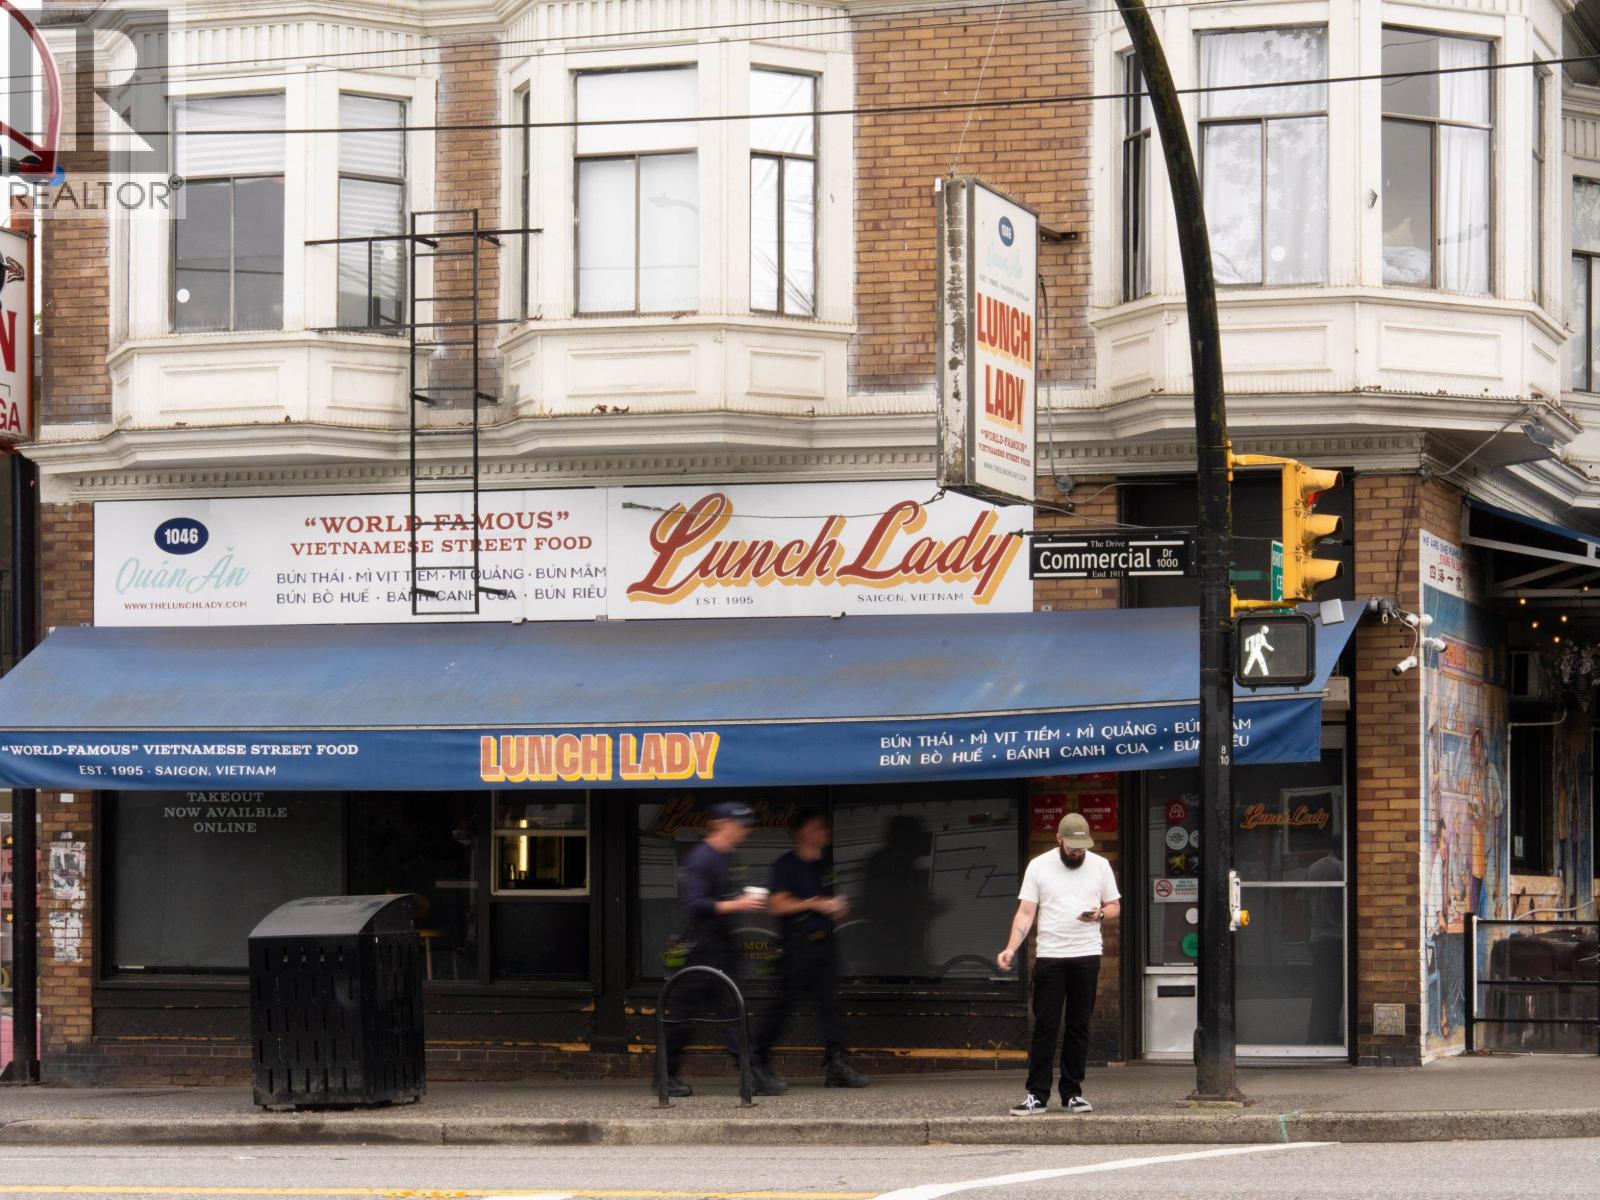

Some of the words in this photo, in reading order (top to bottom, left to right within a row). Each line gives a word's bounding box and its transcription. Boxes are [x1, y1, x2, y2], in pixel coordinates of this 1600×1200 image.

[976, 292, 1033, 371] LUNCH
[984, 364, 1027, 432] LADY
[165, 528, 199, 545] 1046
[1090, 540, 1104, 548] The
[1105, 539, 1125, 548] Drive
[290, 539, 434, 556] VIETNAMESE
[441, 538, 527, 554] STREET
[534, 536, 593, 551] FOOD
[626, 492, 848, 606] Lunch
[835, 499, 1024, 606] Lady
[1039, 549, 1151, 570] Commercial
[1162, 549, 1173, 558] Dr
[1157, 558, 1178, 568] 1000
[115, 556, 189, 595] Quán
[277, 568, 306, 584] BÚN
[310, 568, 345, 584] THÁI
[356, 567, 372, 583] MÌ
[536, 561, 567, 579] BÚN
[1110, 570, 1124, 578] 1911
[276, 588, 306, 604] BÚN
[313, 588, 334, 604] BÒ
[340, 586, 370, 604] HUẾ
[535, 584, 565, 600] BÚN
[696, 597, 721, 605] EST.
[726, 596, 754, 605] 1995
[857, 594, 907, 603] SAIGON,
[911, 592, 964, 602] VIETNAM
[124, 600, 248, 610] WWW.THELUNCHLADY.COM
[880, 733, 912, 748] BÚN
[917, 731, 953, 747] THÁI
[970, 729, 988, 745] MÌ
[994, 731, 1019, 745] VỊT
[1077, 723, 1094, 739] MÌ
[143, 744, 247, 756] VIETNAMESE
[250, 744, 313, 756] STREET
[316, 744, 359, 755] FOOD
[480, 733, 613, 782] LUNCH
[619, 731, 720, 780] LADY
[880, 752, 911, 766] BÚN
[920, 749, 943, 765] BÒ
[952, 746, 983, 763] HUẾ
[1006, 744, 1050, 760] BÁNH
[1060, 744, 1105, 758] CANH
[1115, 742, 1149, 756] CUA
[1219, 755, 1230, 766] 10
[79, 765, 107, 776] EST.
[111, 765, 144, 776] 1995
[155, 765, 212, 777] SAIGON,
[216, 765, 277, 776] VIETNAM
[186, 792, 265, 803] TAKEOUT
[163, 807, 202, 818] NOW
[206, 807, 288, 818] AVAILBLE
[194, 822, 257, 833] ONLINE
